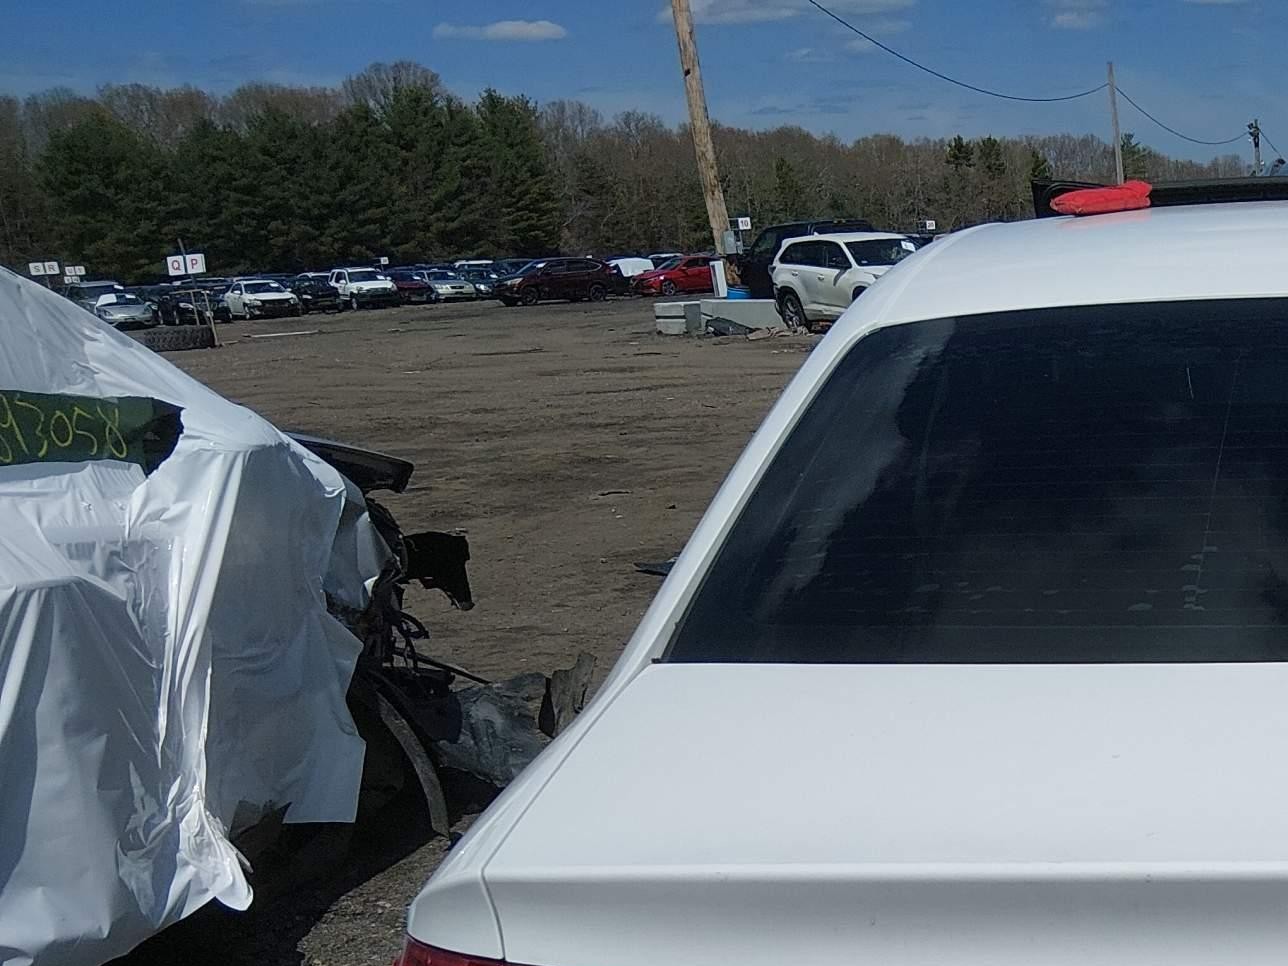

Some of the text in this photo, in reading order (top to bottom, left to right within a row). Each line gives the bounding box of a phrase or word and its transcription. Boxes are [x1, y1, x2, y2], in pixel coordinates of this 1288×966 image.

[740, 219, 749, 228] 10
[171, 258, 198, 271] Q P
